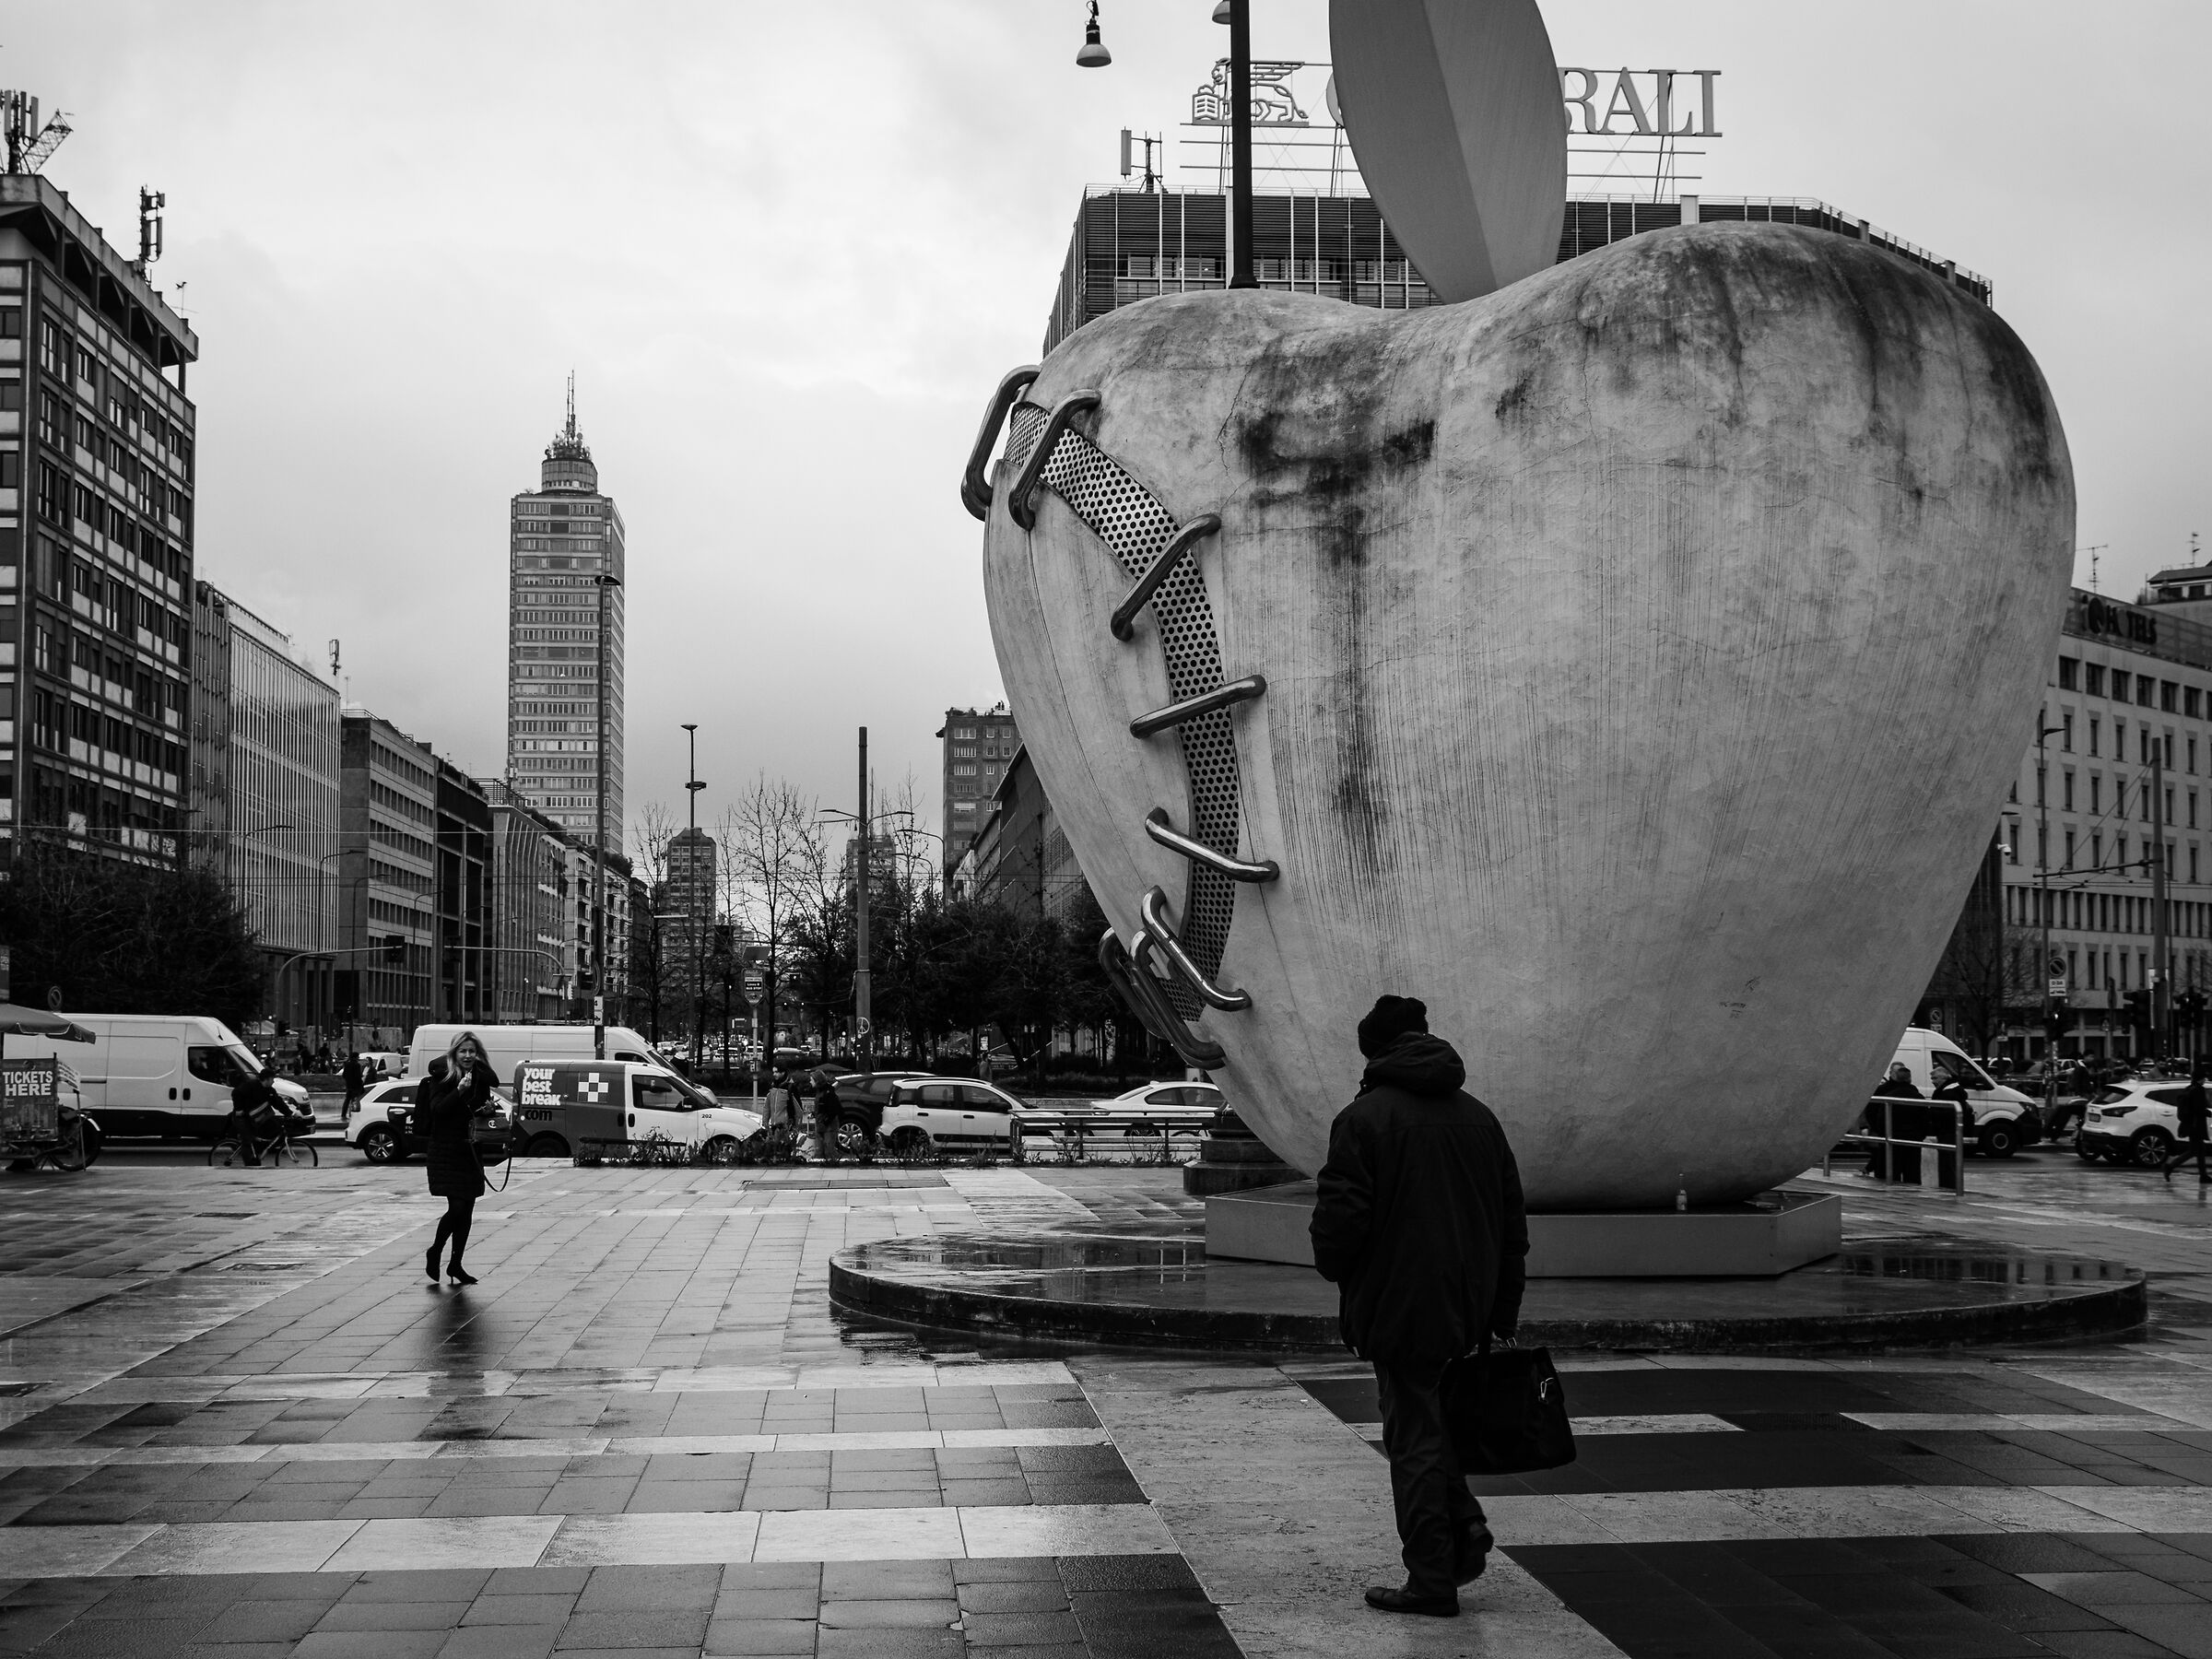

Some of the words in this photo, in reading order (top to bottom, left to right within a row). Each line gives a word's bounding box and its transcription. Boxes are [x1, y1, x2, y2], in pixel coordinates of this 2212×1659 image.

[3, 1071, 53, 1084] TICKETS
[524, 1067, 556, 1080] your
[5, 1083, 52, 1096] HERE
[522, 1078, 552, 1093] best
[521, 1091, 561, 1106] break
